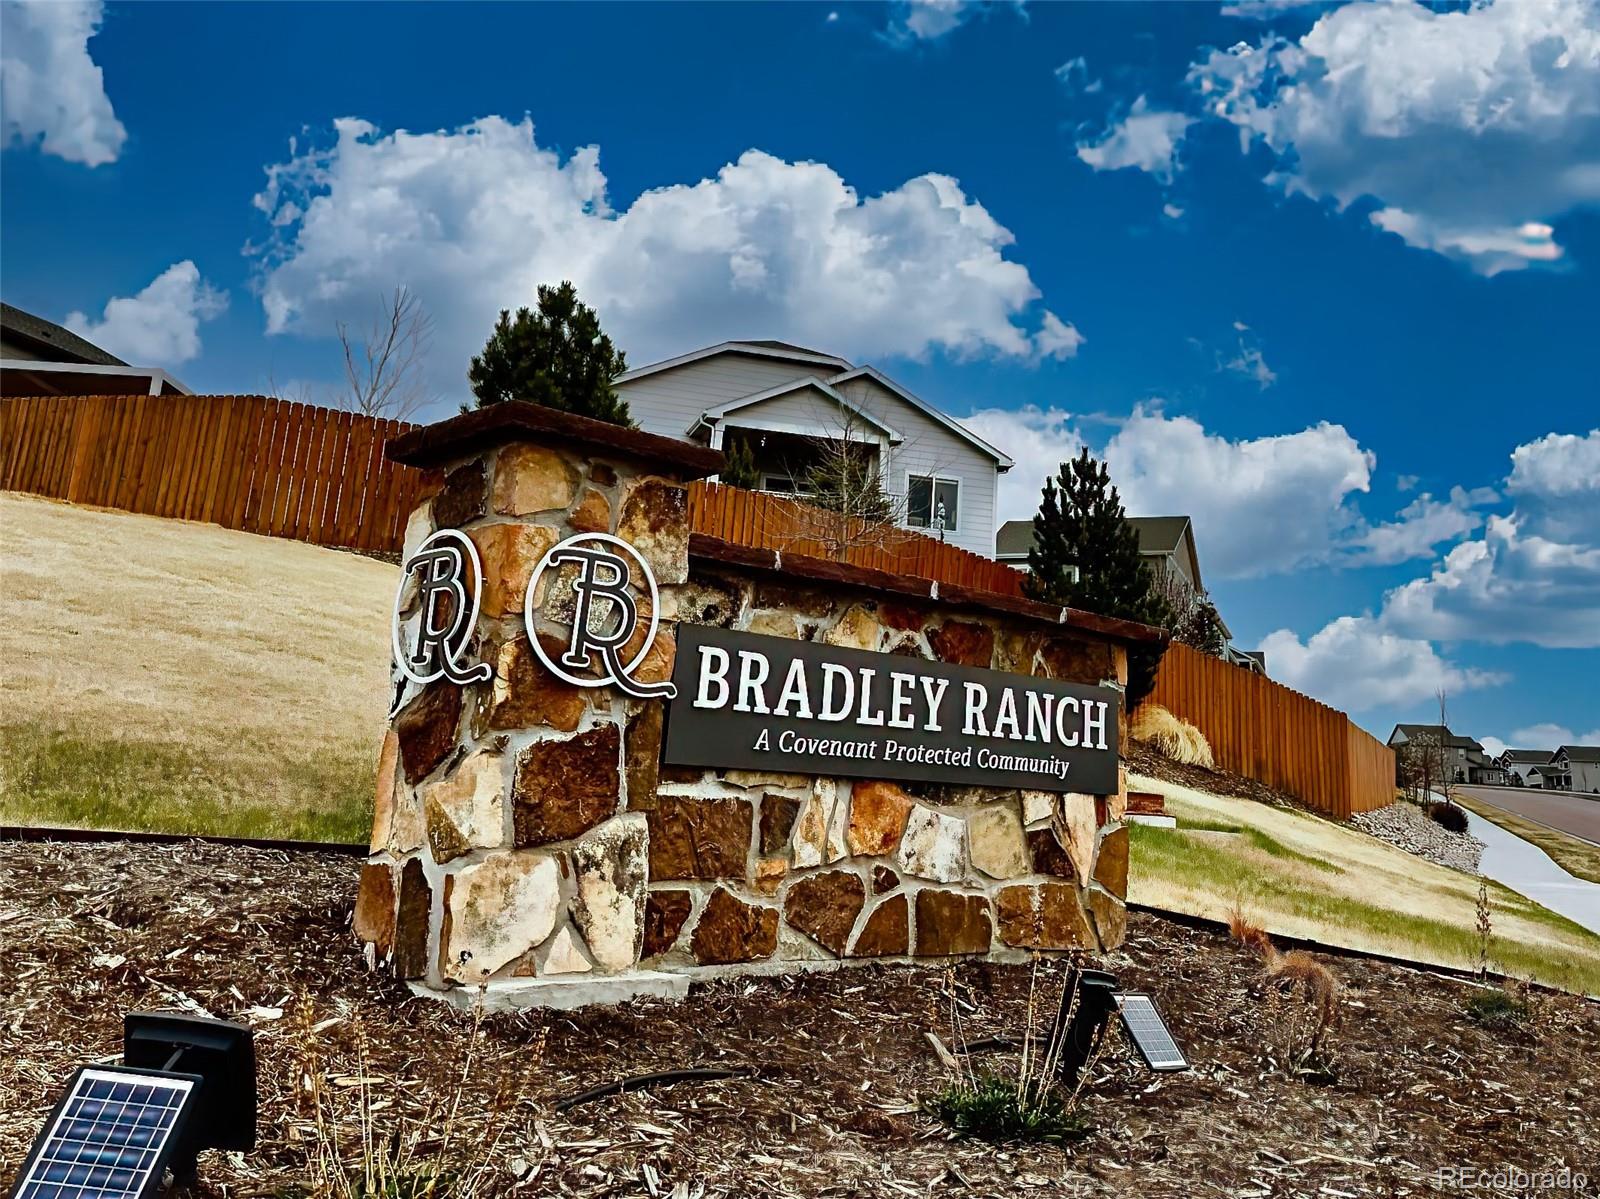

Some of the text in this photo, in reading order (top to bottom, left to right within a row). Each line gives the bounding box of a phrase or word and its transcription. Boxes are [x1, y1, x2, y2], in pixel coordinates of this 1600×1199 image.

[693, 645, 1109, 751] BRADLEY RANCH
[753, 728, 1070, 780] A Covenant Protected Community
